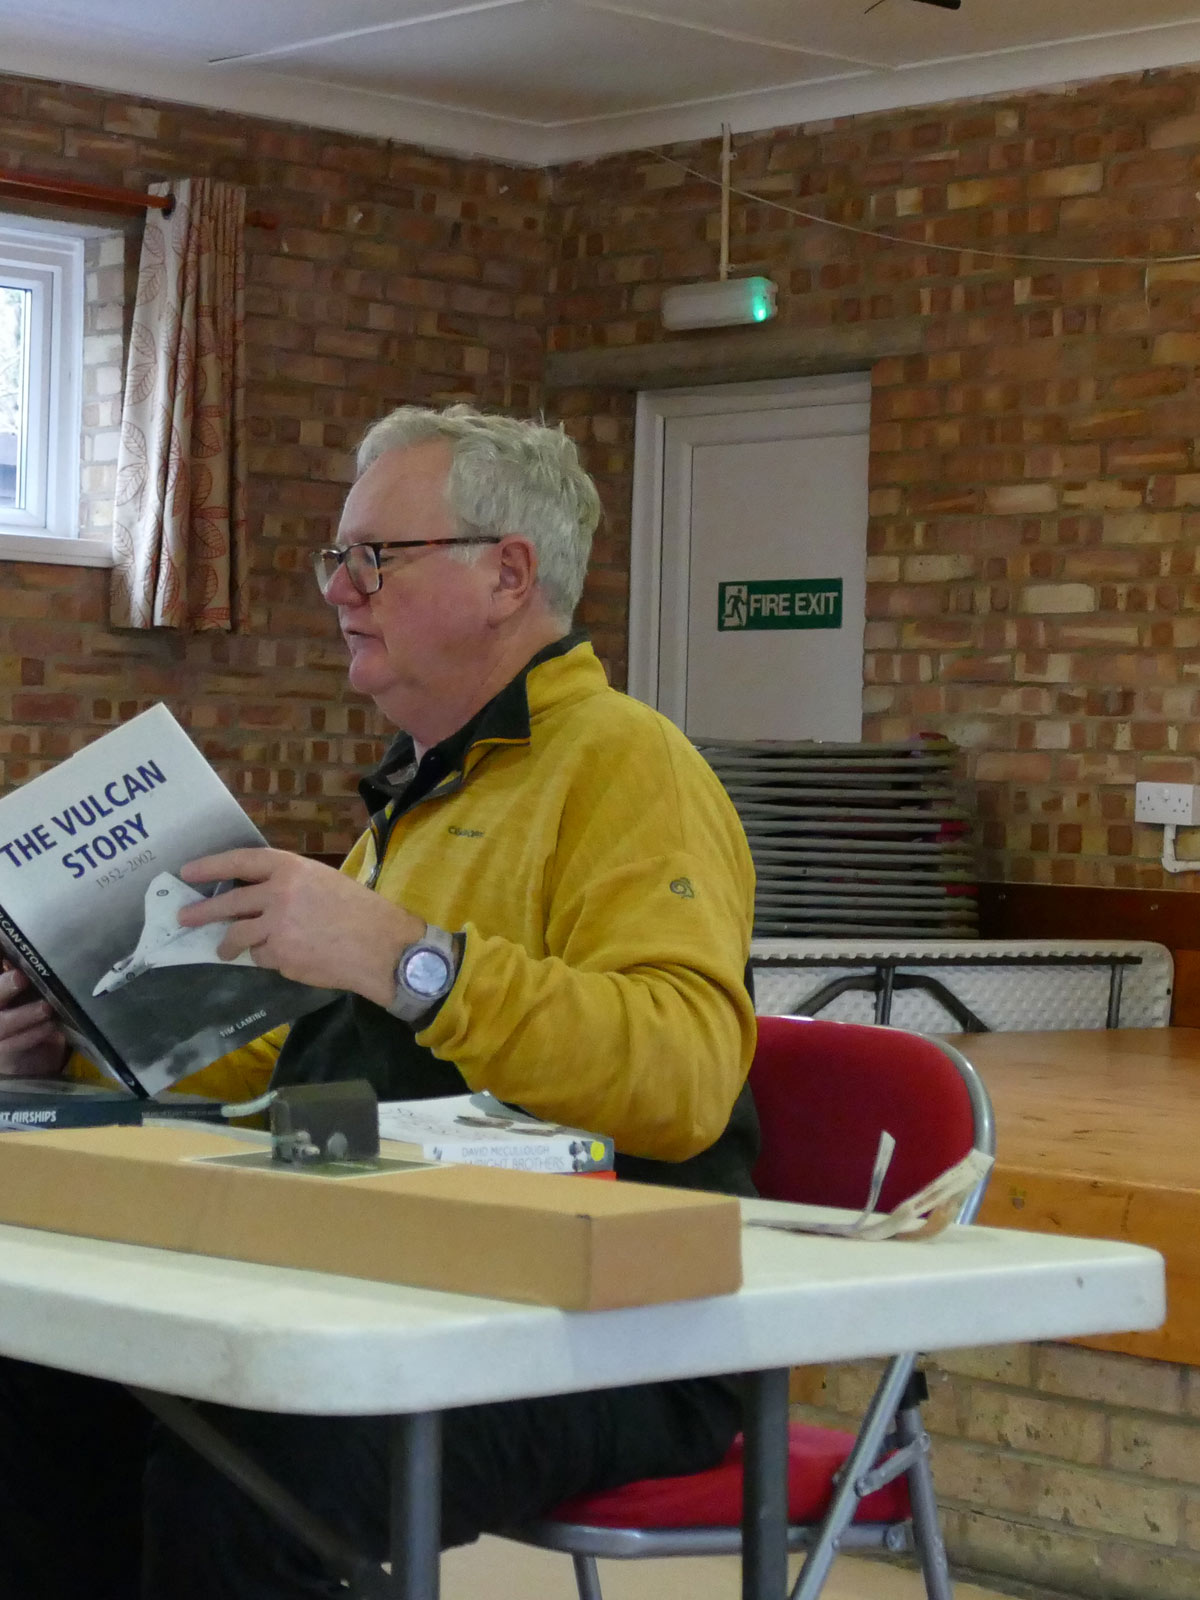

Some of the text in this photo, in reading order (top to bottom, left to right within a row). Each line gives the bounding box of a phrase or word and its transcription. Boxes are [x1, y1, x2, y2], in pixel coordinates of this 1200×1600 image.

[749, 591, 839, 617] FIRE EXIT
[50, 759, 167, 836] VULCAN
[61, 812, 150, 879] STORY
[19, 943, 51, 978] STORY
[219, 1025, 236, 1038] TIM
[11, 1110, 57, 1123] AIRSHIPS
